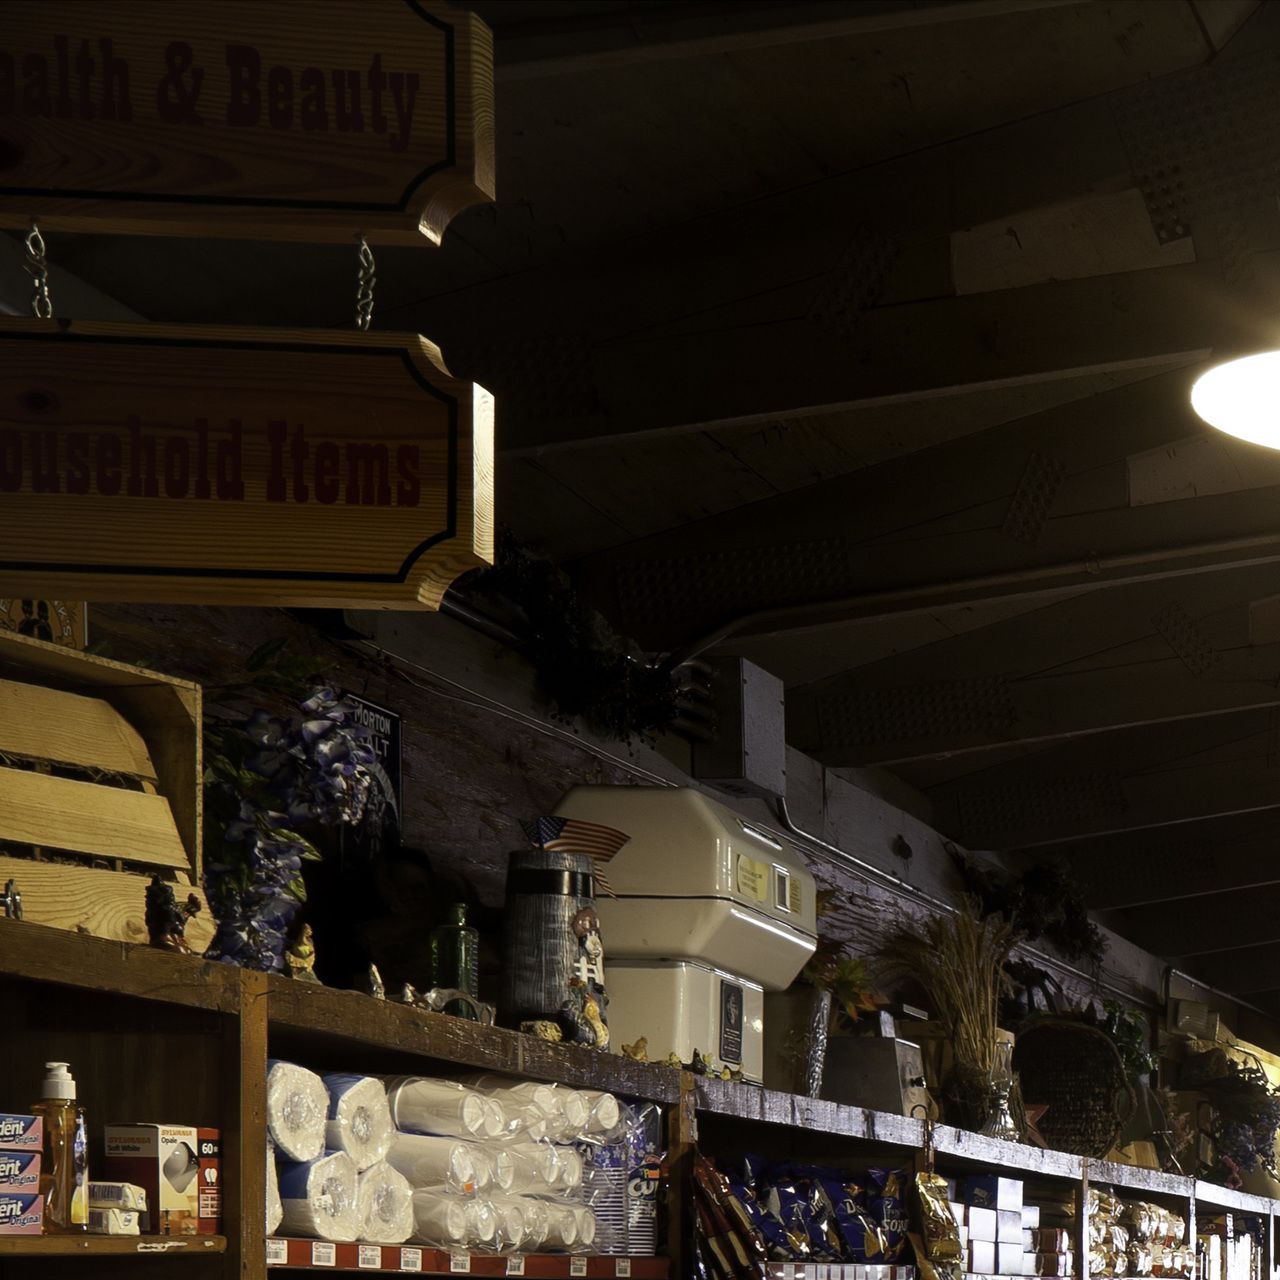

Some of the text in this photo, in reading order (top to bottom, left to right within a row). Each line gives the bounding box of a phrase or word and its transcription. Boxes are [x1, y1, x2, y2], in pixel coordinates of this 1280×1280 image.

[157, 40, 204, 126] &
[226, 44, 419, 153] Beauty
[267, 420, 421, 507] Items
[354, 703, 391, 734] MORTON
[360, 735, 390, 757] ALT
